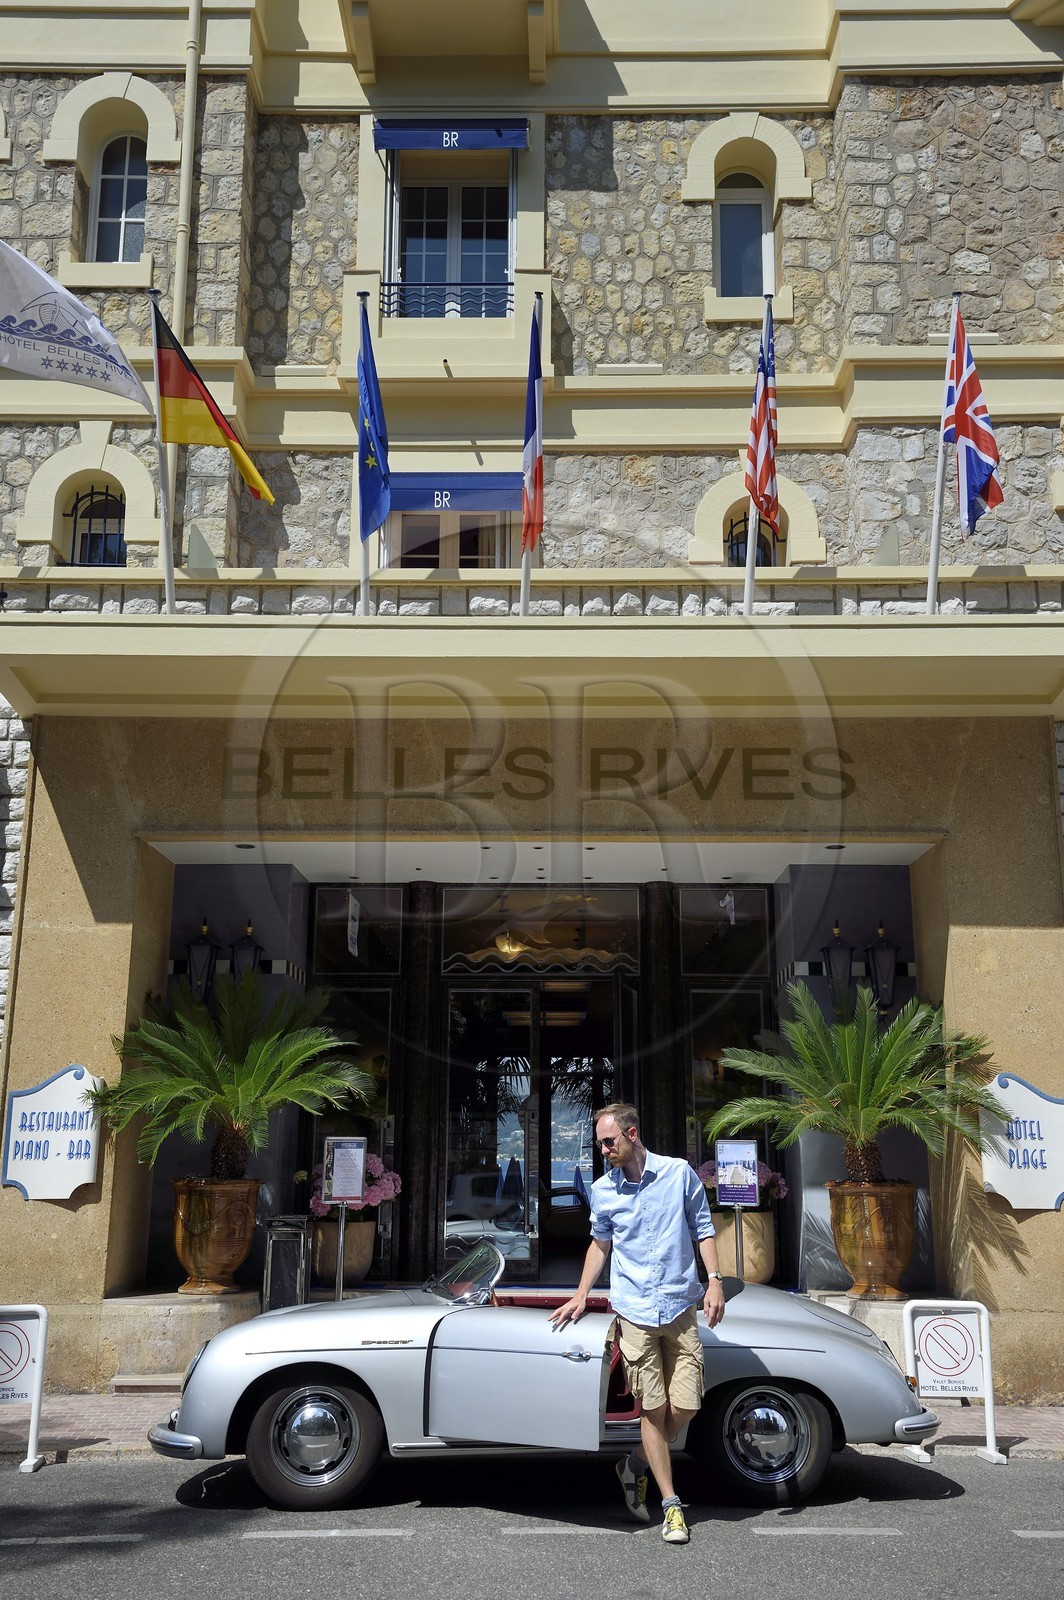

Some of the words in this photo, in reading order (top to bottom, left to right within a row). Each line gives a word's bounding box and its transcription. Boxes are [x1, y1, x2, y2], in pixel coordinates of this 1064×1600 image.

[442, 131, 459, 147] BR
[47, 344, 101, 366] BELLES
[434, 491, 451, 508] BR
[221, 747, 555, 801] BELLES
[590, 747, 856, 801] RIVES
[18, 1111, 90, 1132] RESTAURANT
[1005, 1116, 1044, 1140] HÔTEL
[13, 1139, 50, 1161] PIANO
[66, 1139, 92, 1161] BAR
[1008, 1148, 1048, 1170] PLAGE
